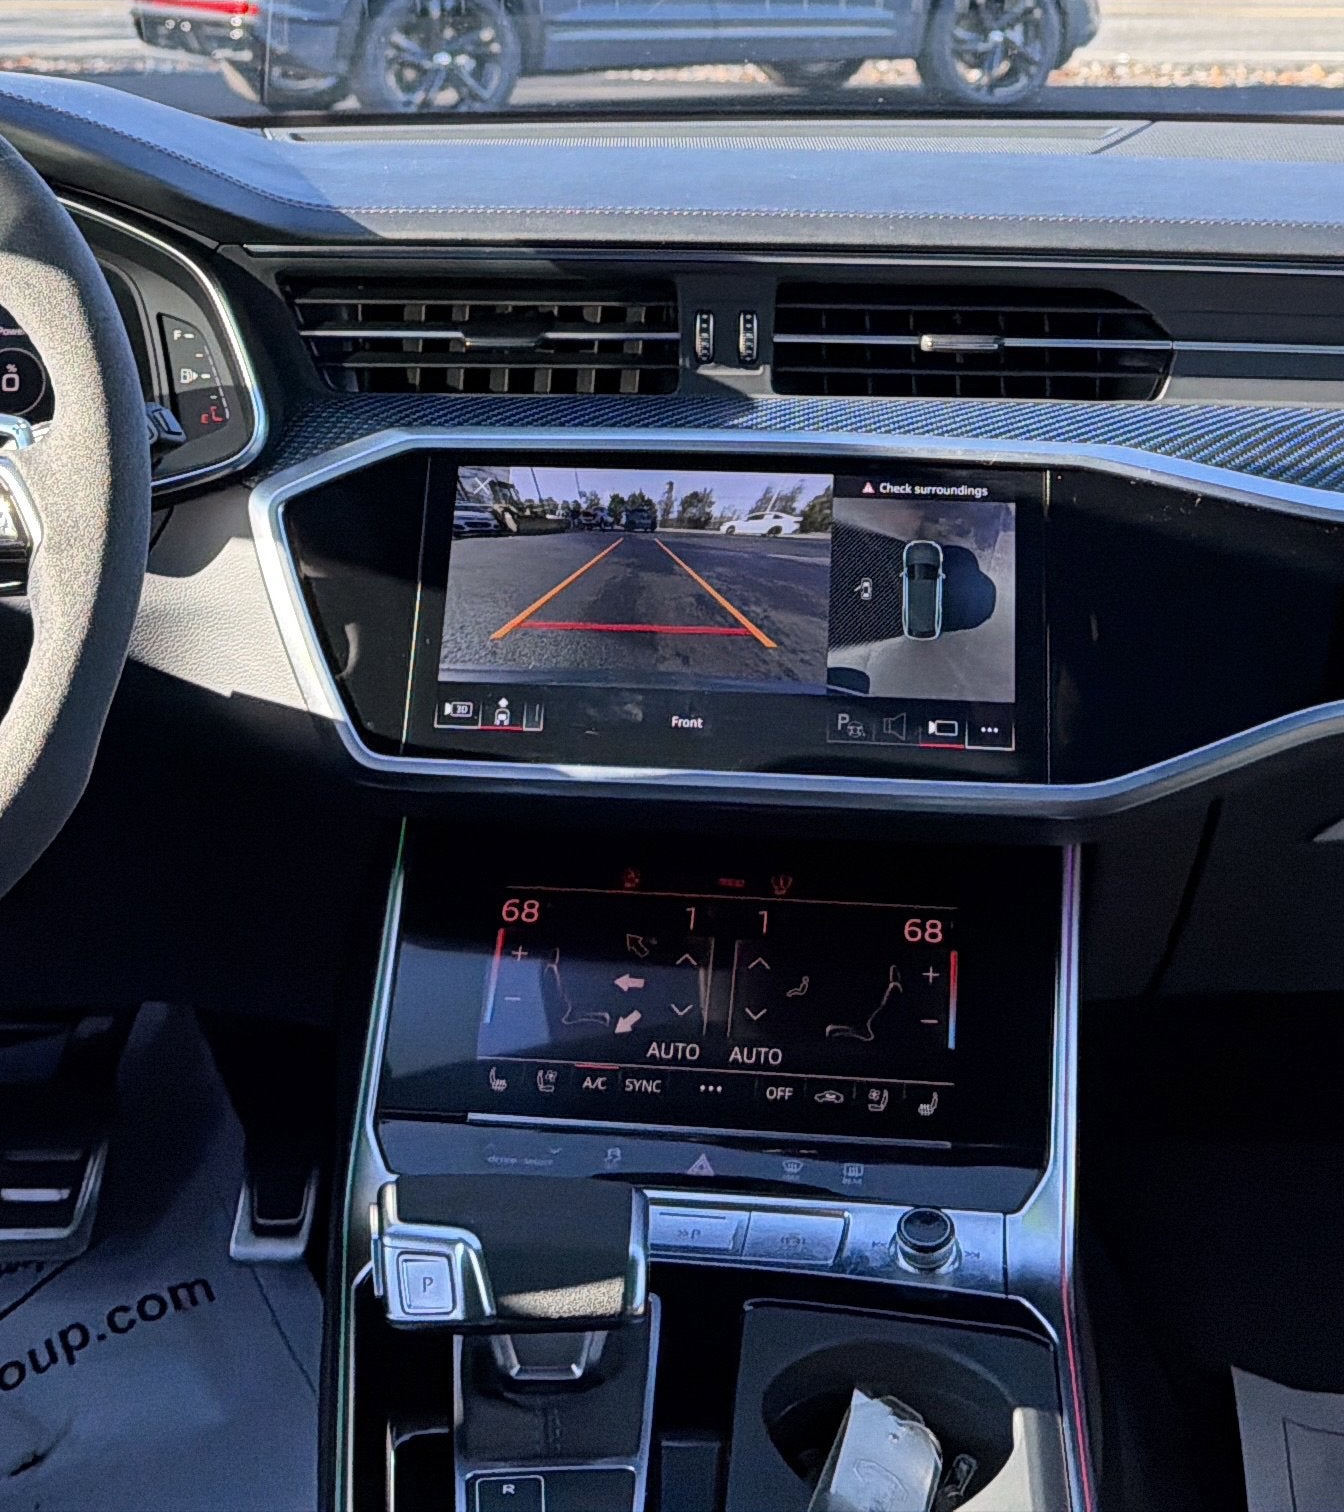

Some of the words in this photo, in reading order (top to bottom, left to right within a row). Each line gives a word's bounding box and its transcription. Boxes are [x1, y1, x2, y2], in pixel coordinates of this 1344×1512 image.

[173, 330, 182, 341] F
[1, 373, 20, 393] 0
[200, 413, 209, 424] E
[879, 481, 911, 497] Check
[913, 482, 989, 500] surroundings
[671, 714, 704, 730] Front
[501, 899, 541, 923] 68
[686, 906, 696, 931] 1
[758, 910, 768, 934] 1
[903, 919, 944, 944] 68
[646, 1041, 701, 1062] AUTO
[729, 1045, 783, 1066] AUTO
[582, 1075, 608, 1091] A/C
[624, 1077, 662, 1094] SYNC
[766, 1086, 794, 1101] OFF
[421, 1276, 434, 1294] P
[502, 1483, 515, 1494] R
